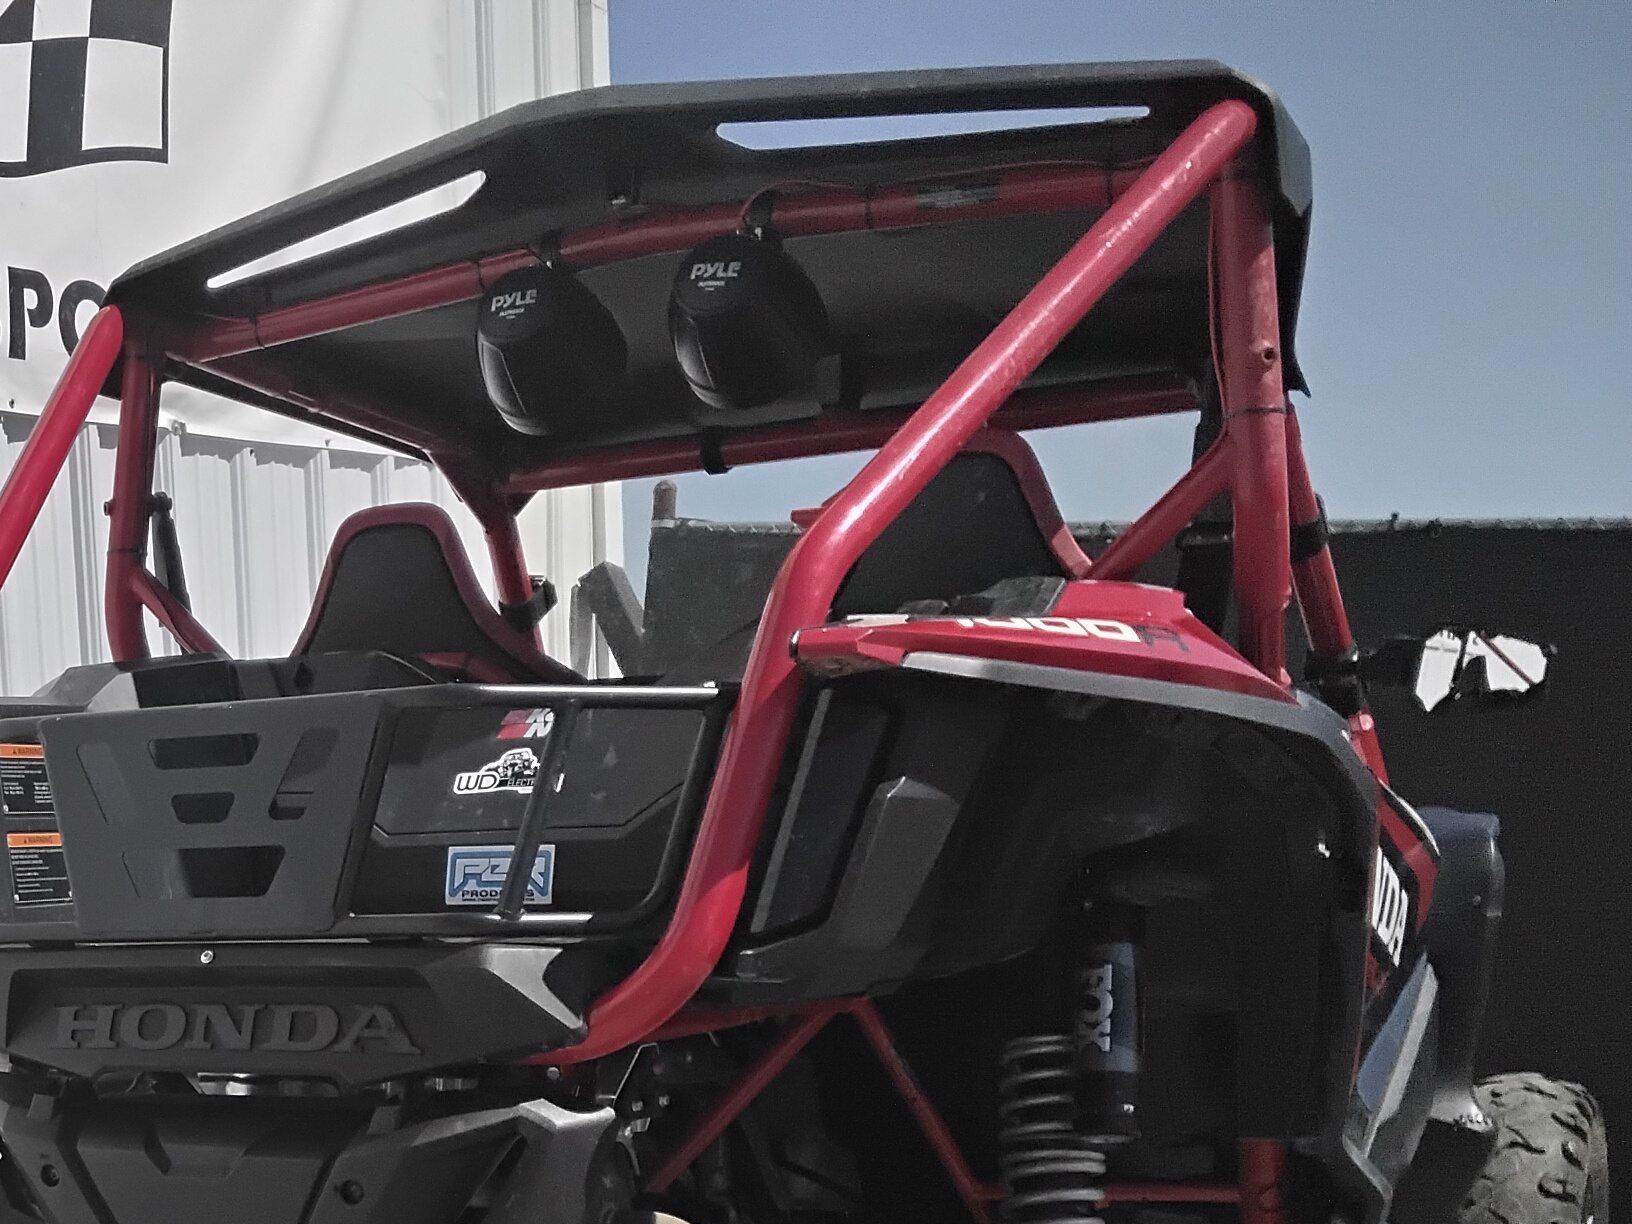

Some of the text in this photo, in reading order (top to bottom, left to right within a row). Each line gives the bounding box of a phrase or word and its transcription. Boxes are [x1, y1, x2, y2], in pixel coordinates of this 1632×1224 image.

[690, 261, 741, 280] PYLE
[491, 289, 537, 311] PYLE
[456, 773, 498, 791] WD
[461, 889, 535, 898] PRODS
[1078, 963, 1114, 1052] FOX
[51, 1003, 424, 1055] HONDA
